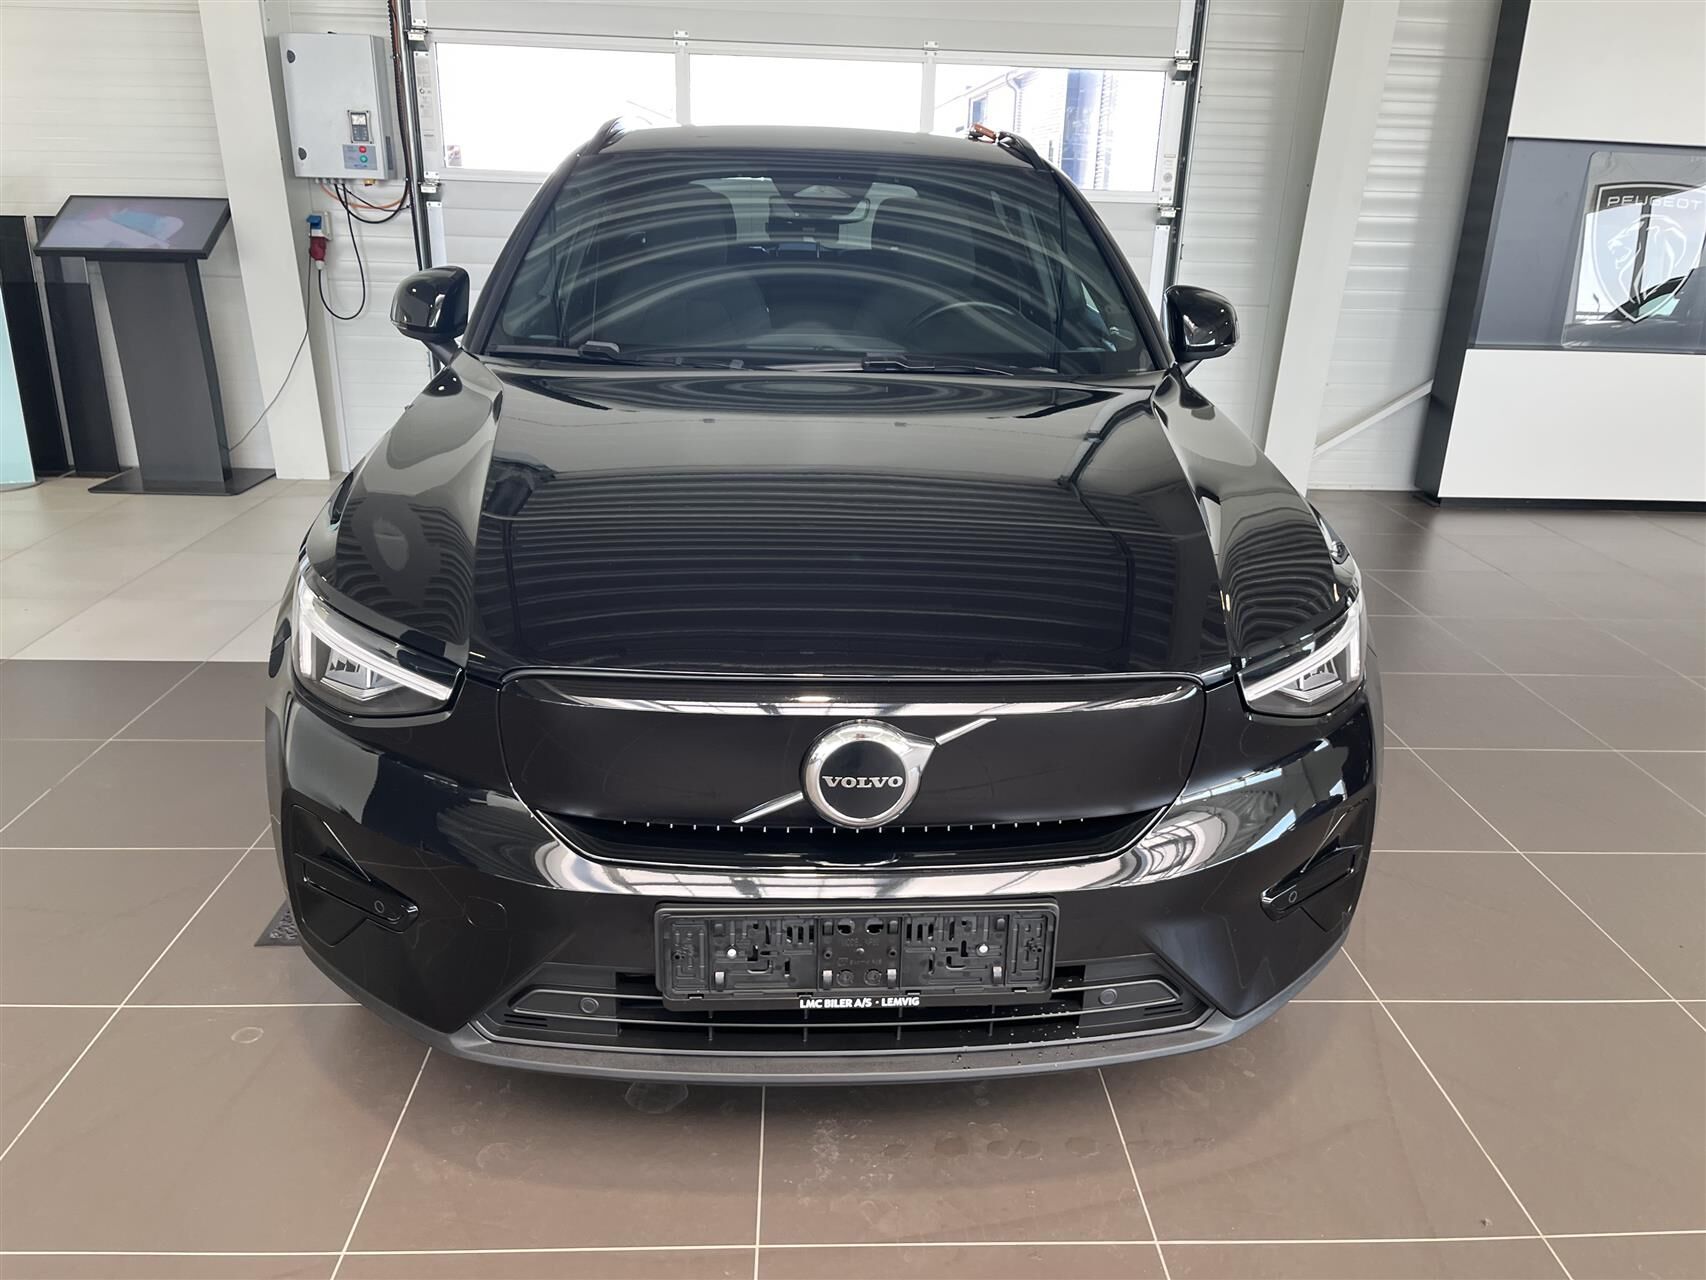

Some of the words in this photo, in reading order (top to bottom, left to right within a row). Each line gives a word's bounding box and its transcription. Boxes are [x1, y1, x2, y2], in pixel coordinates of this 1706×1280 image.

[1607, 195, 1703, 210] PEUGEOT
[822, 776, 904, 788] VOLVO
[800, 999, 822, 1009] LMC
[824, 998, 852, 1008] BILER
[853, 997, 873, 1008] A/S
[881, 996, 920, 1007] LEMVIG
